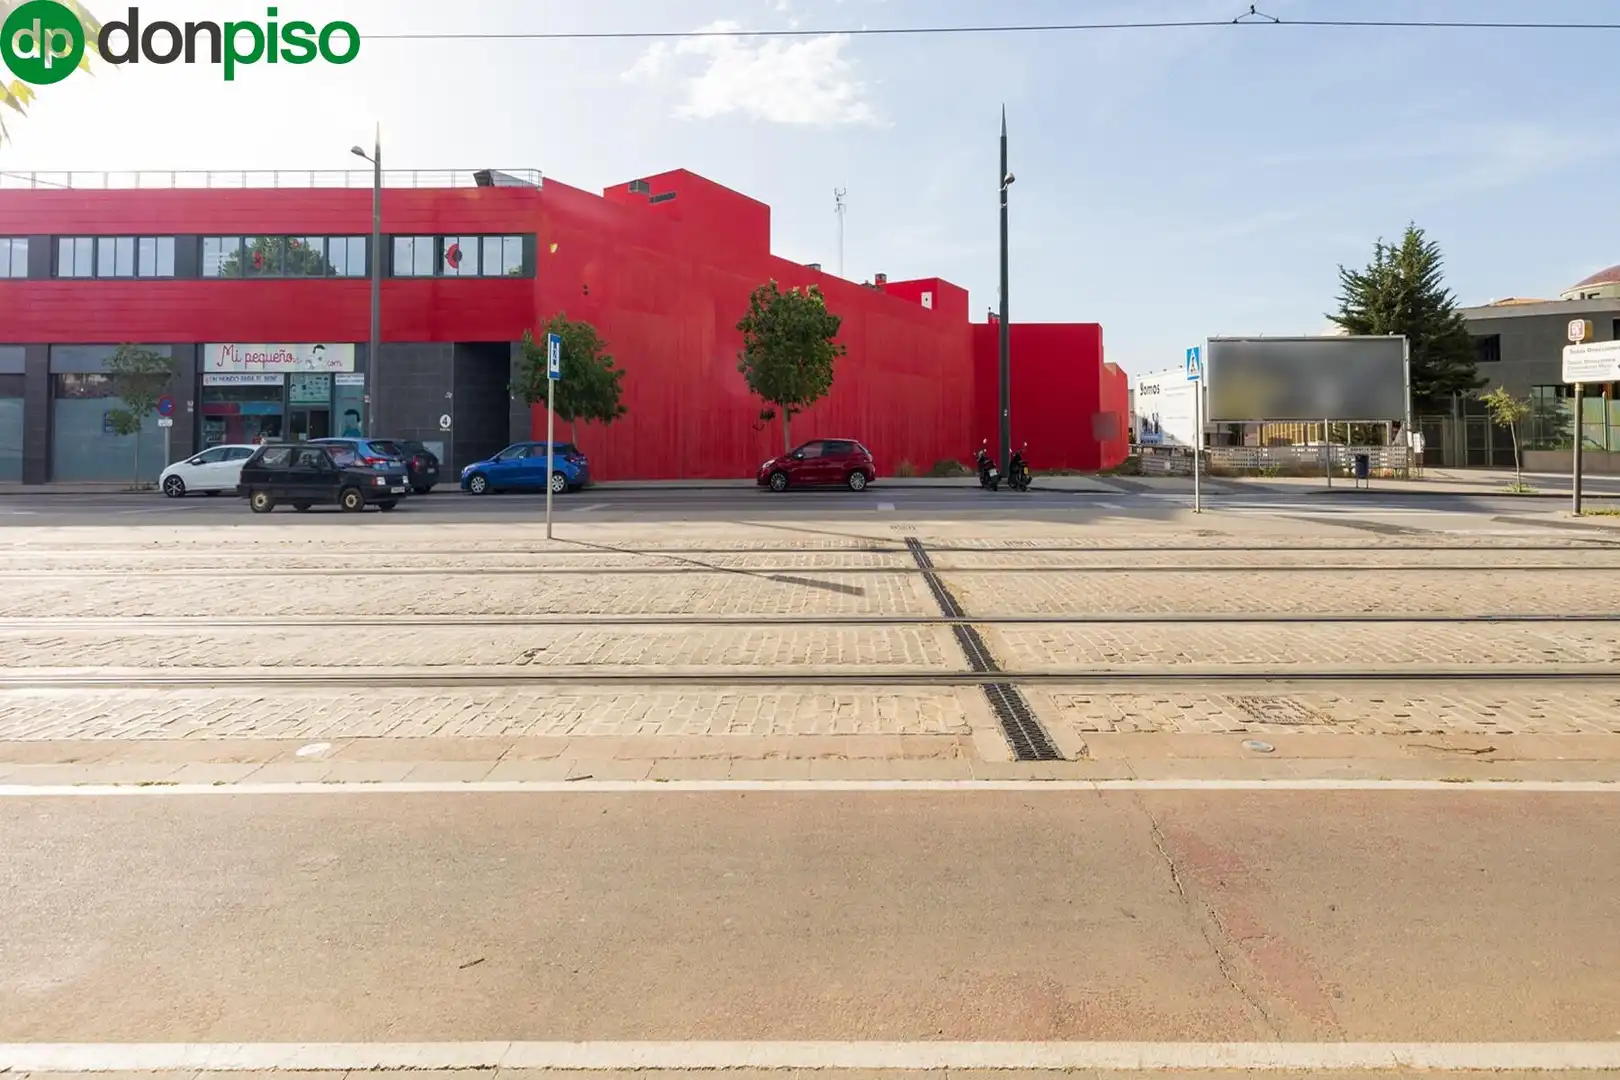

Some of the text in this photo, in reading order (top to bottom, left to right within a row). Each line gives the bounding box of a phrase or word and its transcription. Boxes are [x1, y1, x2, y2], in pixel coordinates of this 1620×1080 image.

[216, 344, 241, 367] Mi
[244, 348, 294, 370] pequeño
[442, 415, 448, 426] 4
